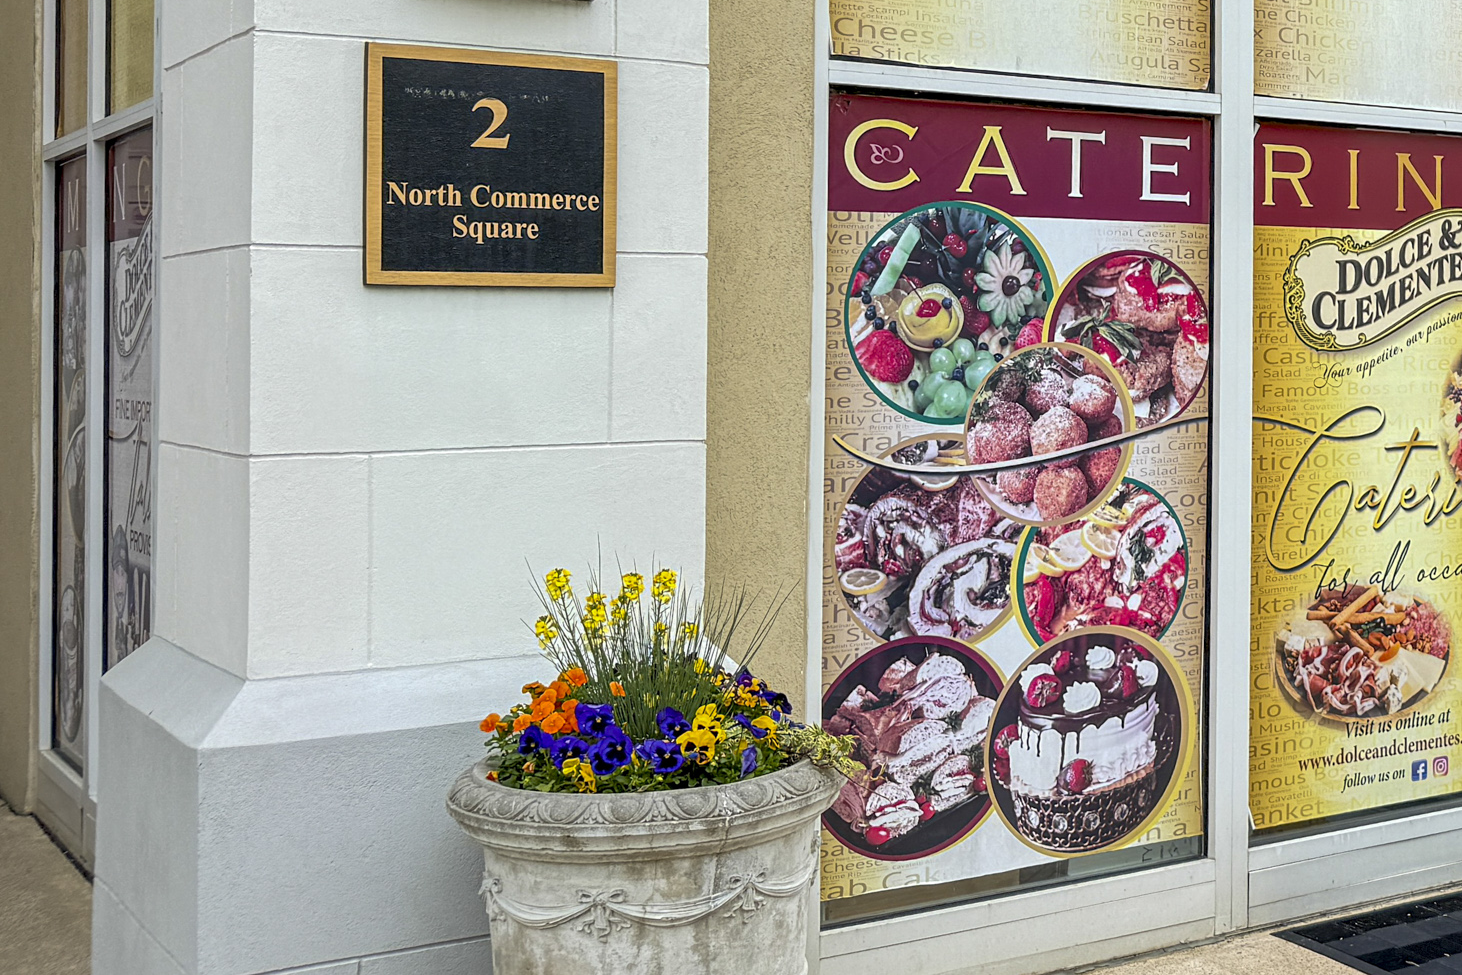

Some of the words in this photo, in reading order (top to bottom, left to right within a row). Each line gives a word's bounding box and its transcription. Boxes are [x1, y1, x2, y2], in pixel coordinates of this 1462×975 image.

[834, 17, 955, 47] Cheese
[1126, 31, 1163, 45] Bean
[1168, 36, 1207, 50] Salad
[871, 45, 941, 65] Sticks
[470, 97, 512, 150] 2
[387, 181, 462, 207] North
[470, 184, 600, 212] Commerce
[452, 214, 540, 245] Square
[1137, 229, 1177, 239] Caesar
[1336, 228, 1433, 296] DOLCE
[1313, 361, 1352, 389] Your
[1355, 345, 1404, 379] appetite,
[1406, 332, 1425, 348] our
[1263, 367, 1301, 379] Salad
[1262, 383, 1340, 398] Famous
[115, 398, 130, 420] FINE
[1150, 456, 1179, 465] Salad
[1140, 466, 1178, 477] Salad
[1170, 477, 1200, 487] Salad
[1265, 572, 1308, 584] Roasters
[1311, 558, 1358, 600] for
[1369, 540, 1411, 596] all
[1259, 584, 1299, 595] Summer
[1345, 720, 1374, 740] Visit
[1378, 720, 1393, 733] us
[1396, 712, 1433, 731] online
[1435, 708, 1452, 724] at
[1341, 771, 1377, 793] follow
[1378, 770, 1391, 783] us
[1392, 768, 1406, 781] on
